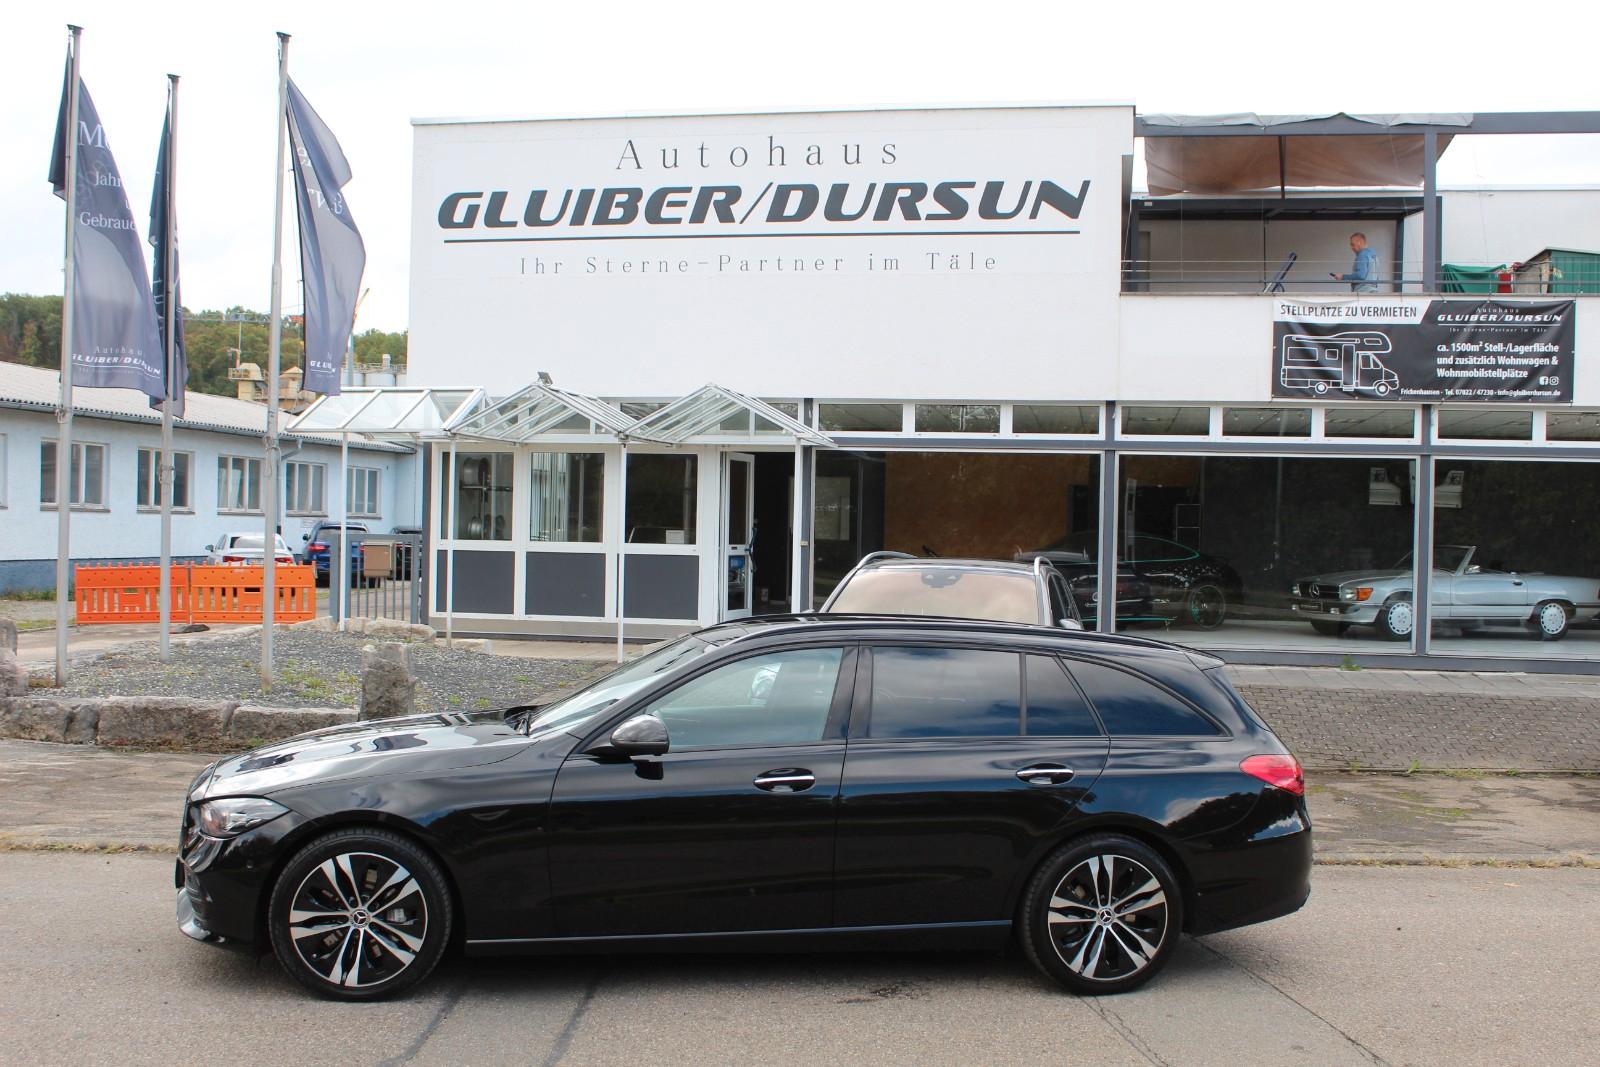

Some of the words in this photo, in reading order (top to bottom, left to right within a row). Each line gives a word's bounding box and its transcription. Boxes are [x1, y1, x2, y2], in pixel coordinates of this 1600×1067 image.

[616, 136, 897, 170] Autohaus
[438, 179, 1091, 229] GLUIBER/DURSUN
[521, 257, 564, 275] Ihr
[586, 254, 844, 274] Sterne-Partner
[868, 252, 899, 271] im
[926, 251, 996, 271] Täle
[1345, 306, 1358, 317] ZU
[1360, 306, 1417, 318] VERMIETEN
[1437, 314, 1563, 322] GLUIBER/DURSUN
[1437, 344, 1449, 352] ca.
[1484, 342, 1559, 354] Stell-/Lagerfläche
[1437, 355, 1453, 365] und
[1455, 355, 1495, 365] zusätzlich
[1497, 356, 1550, 367] Wohnwagen
[1551, 356, 1559, 366] &
[1436, 368, 1528, 379] Wohnmobilstellplätze
